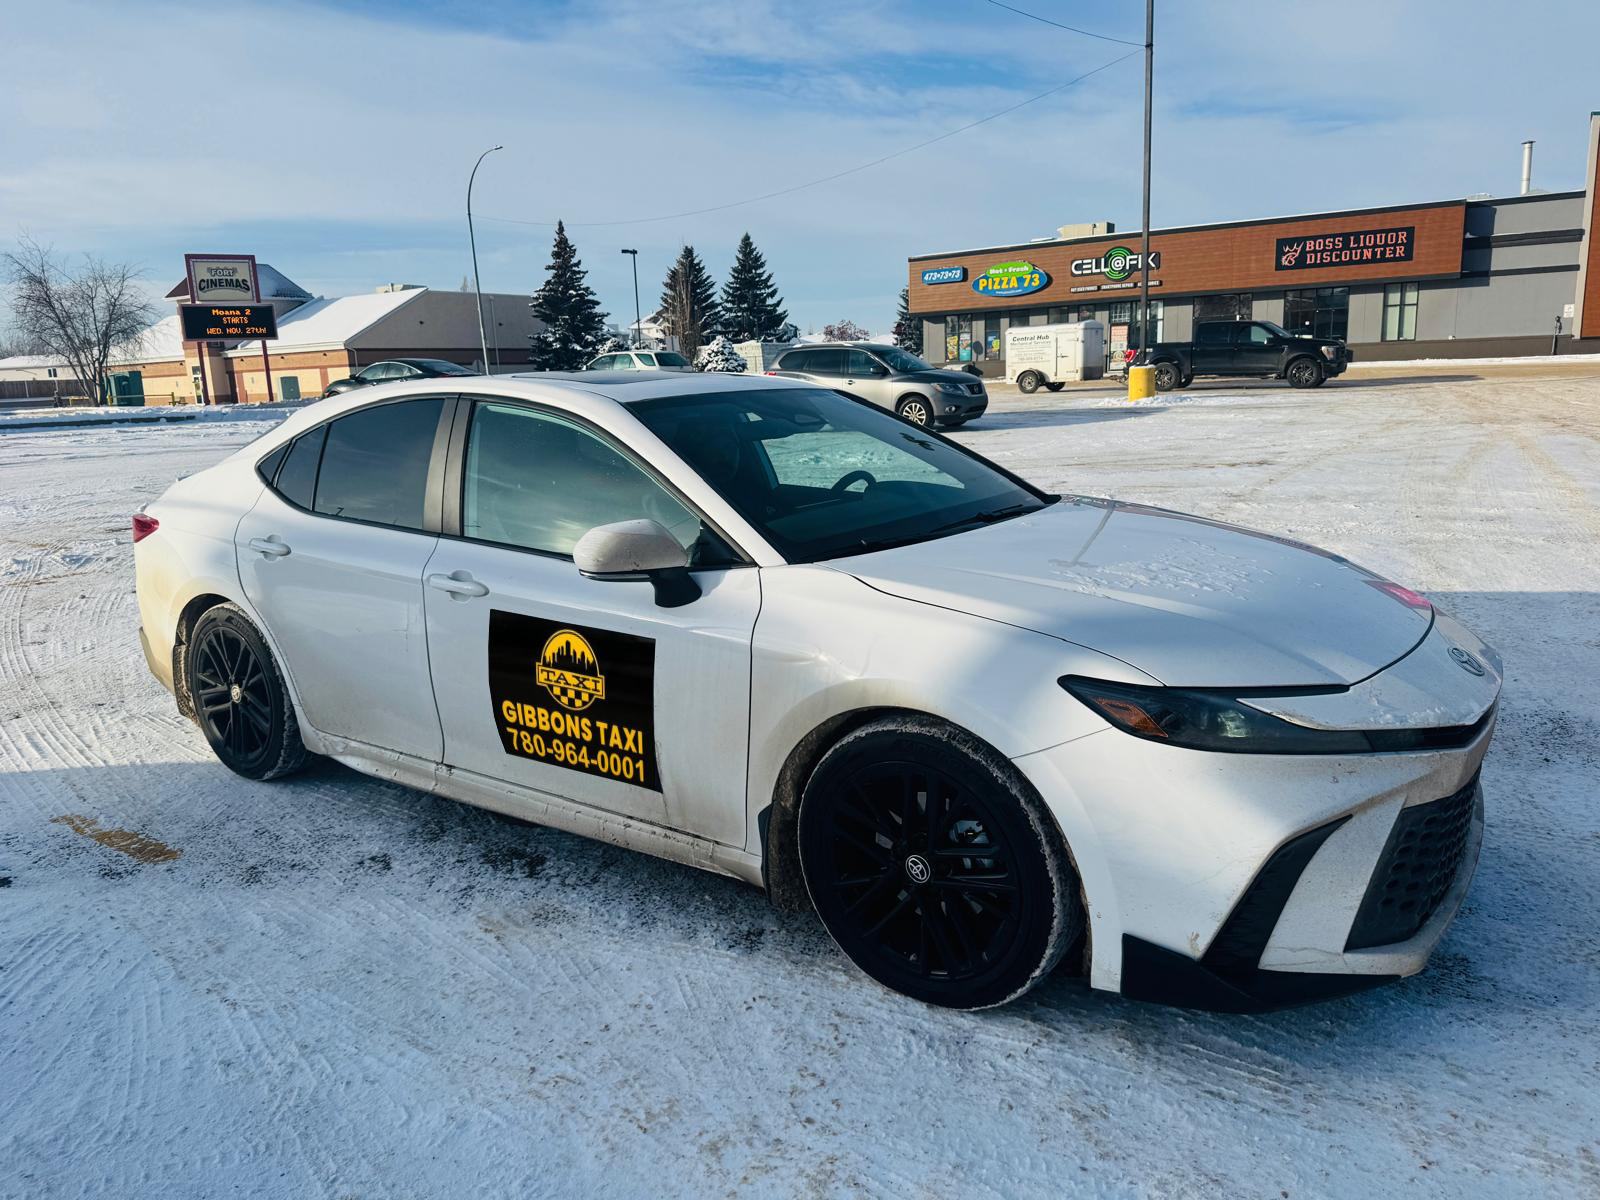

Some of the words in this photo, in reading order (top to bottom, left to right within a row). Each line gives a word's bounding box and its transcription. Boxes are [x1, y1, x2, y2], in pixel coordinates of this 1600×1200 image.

[1305, 237, 1343, 251] BOSS
[1349, 231, 1407, 248] LIQUOR
[1306, 245, 1405, 264] DISCOUNTER
[211, 268, 234, 277] FORT
[198, 278, 250, 292] CINEMAS
[978, 275, 1018, 291] PIZZA
[1023, 273, 1040, 287] 73
[211, 308, 241, 316] Moana
[245, 308, 251, 316] 2
[222, 316, 249, 324] STARTS
[206, 327, 224, 335] WED.
[226, 327, 243, 335] NOV.
[245, 326, 267, 334] 27th!
[1036, 333, 1050, 341] Hub
[540, 668, 601, 693] TAXI
[502, 700, 593, 742] GIBBONS
[596, 720, 644, 755] TAXI
[506, 726, 645, 783] 780-964-0001
